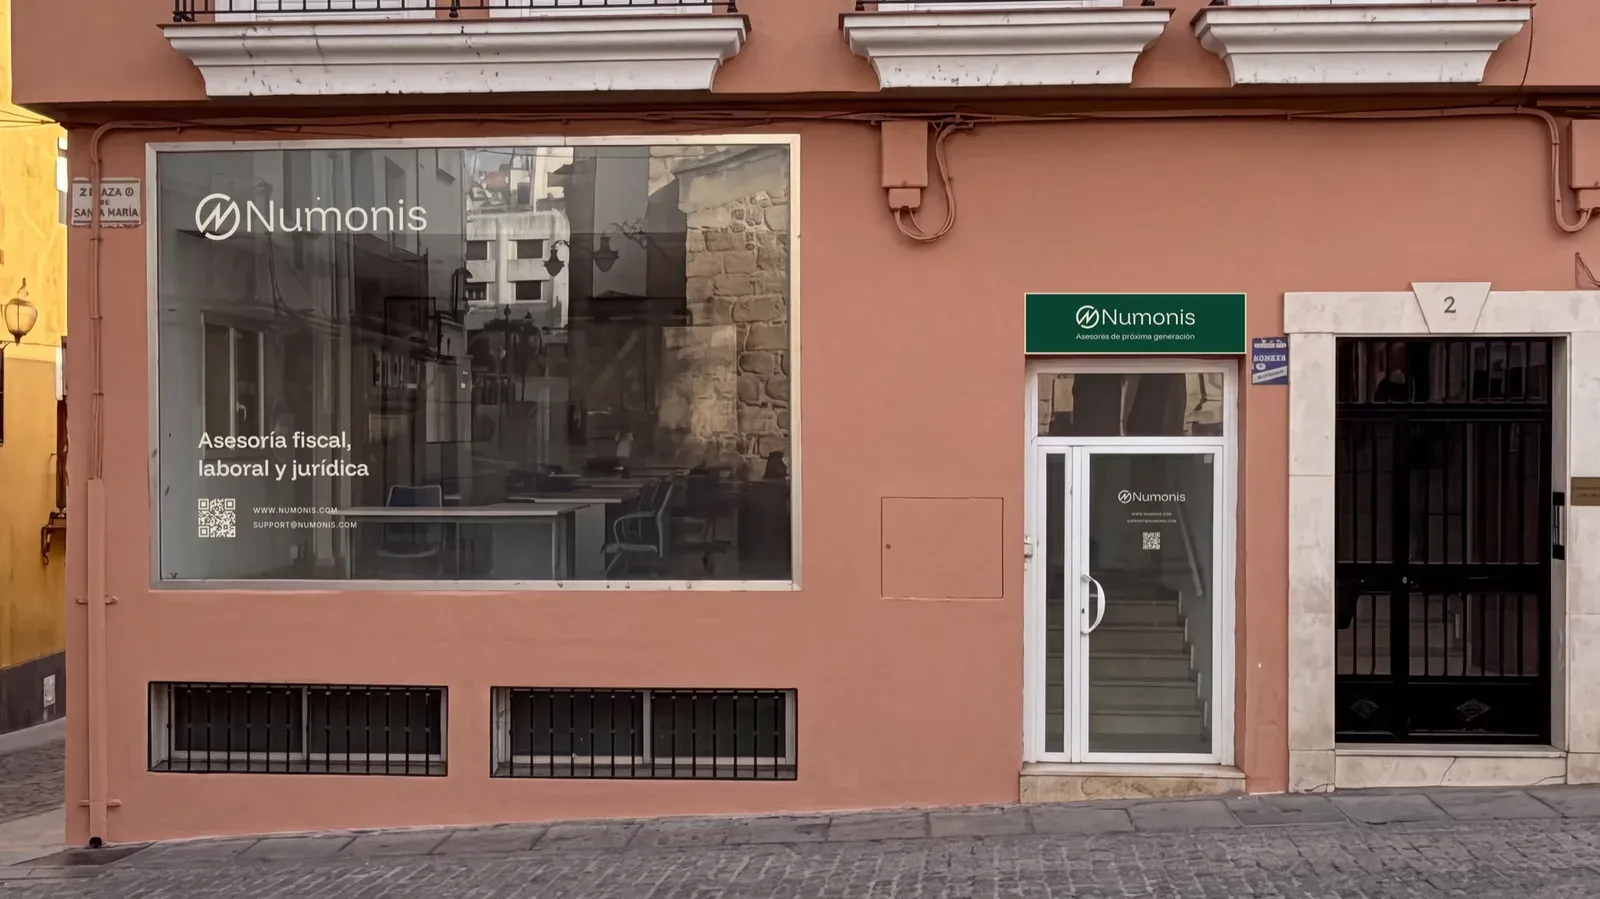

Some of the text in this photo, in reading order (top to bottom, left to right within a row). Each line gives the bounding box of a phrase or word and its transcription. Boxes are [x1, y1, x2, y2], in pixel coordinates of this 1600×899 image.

[89, 188, 122, 197] AZA
[74, 205, 138, 217] SANA MARÍA
[247, 199, 427, 232] Numonis
[1444, 296, 1457, 314] 2
[1102, 308, 1196, 325] Numonis
[1121, 333, 1152, 342] próxima
[1153, 333, 1195, 342] generación
[198, 431, 352, 452] Asesoría fiscal,
[199, 459, 370, 481] laboral y jurídica
[1132, 492, 1186, 502] Numonis
[253, 521, 357, 529] SUPPORT@NUMONIS.COM
